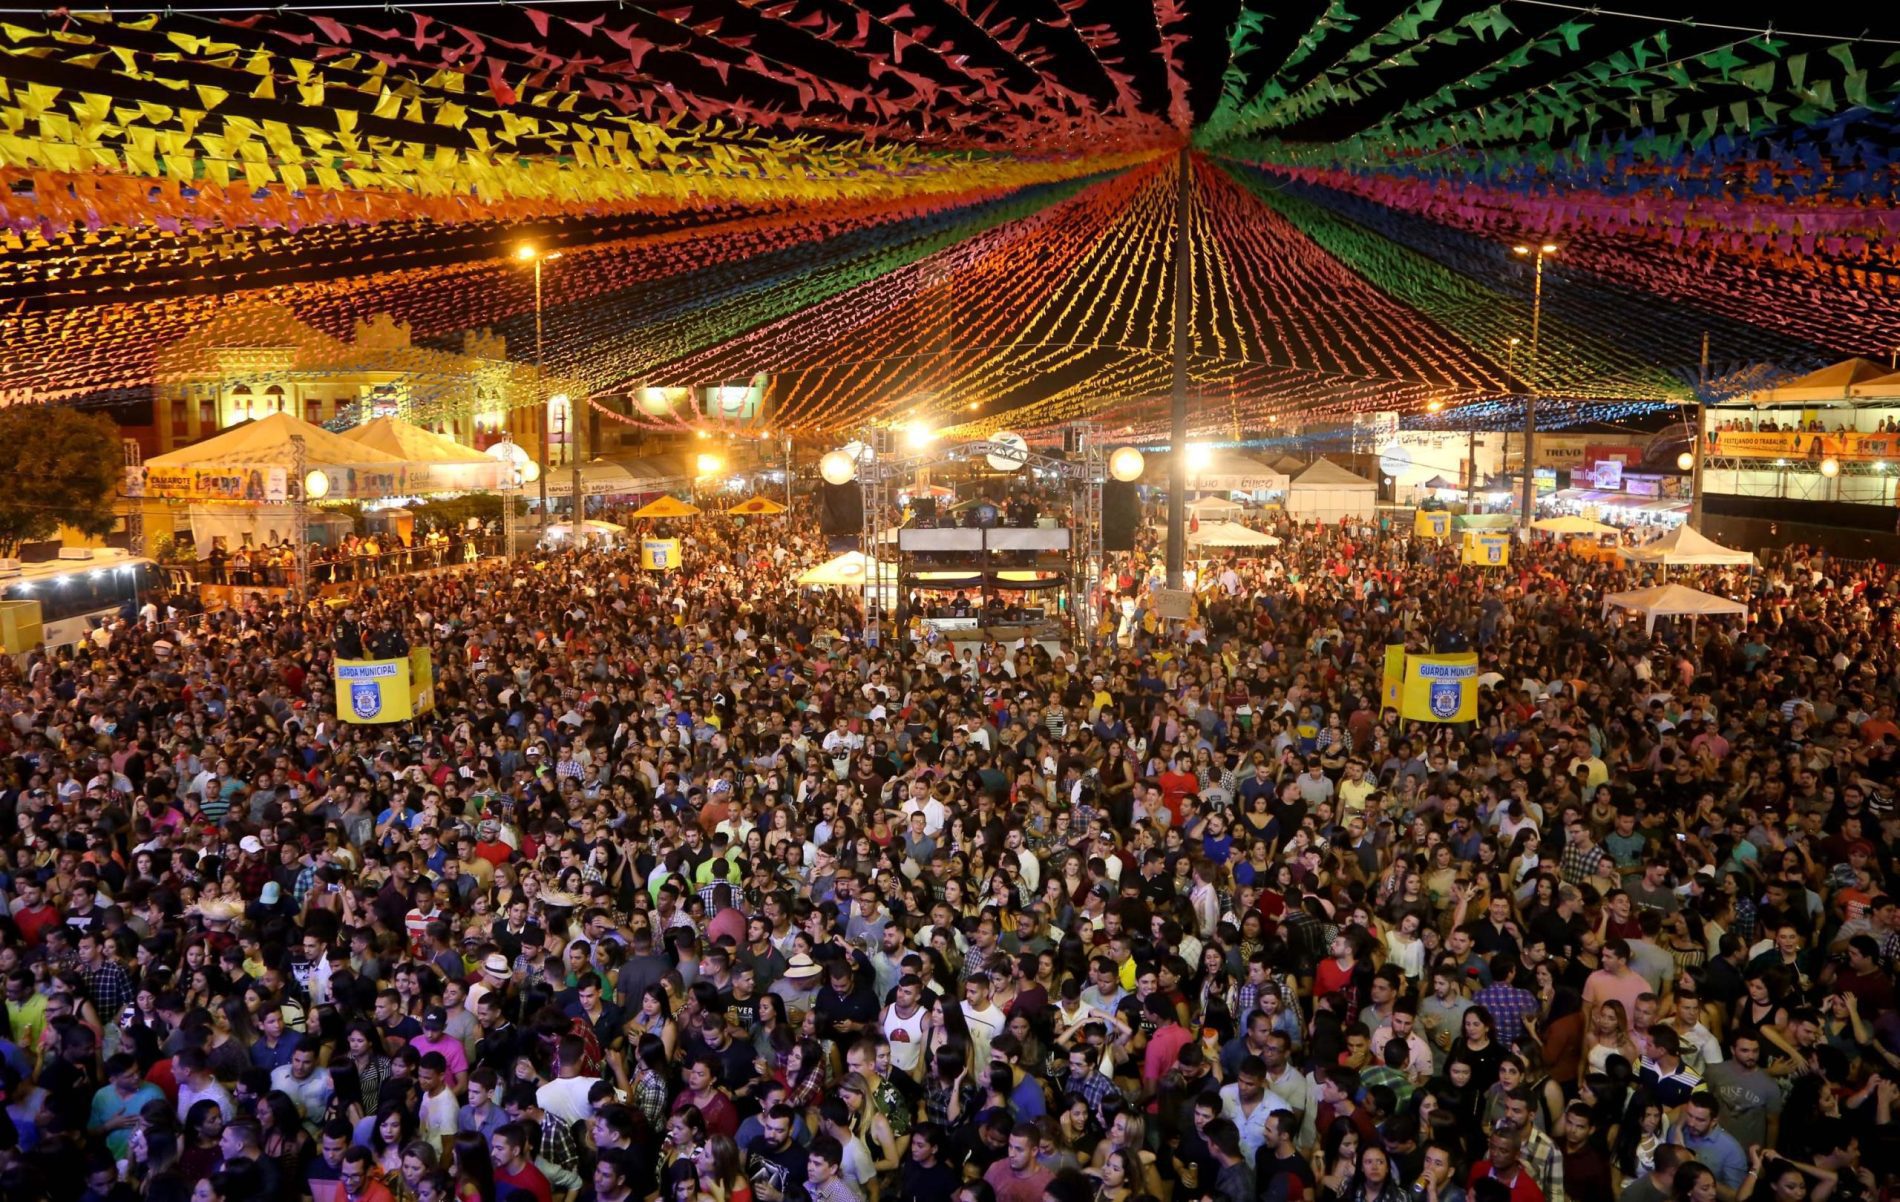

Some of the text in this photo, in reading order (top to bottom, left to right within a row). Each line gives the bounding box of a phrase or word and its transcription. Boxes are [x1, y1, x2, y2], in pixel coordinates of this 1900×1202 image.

[1723, 438, 1753, 446] FESTEJANDO
[1545, 449, 1581, 457] TREVO
[151, 477, 191, 485] CAMAROTE
[360, 665, 396, 677] MUNICIPAL
[1420, 665, 1448, 677] GUARDA
[1720, 1086, 1760, 1104] RISE UP
